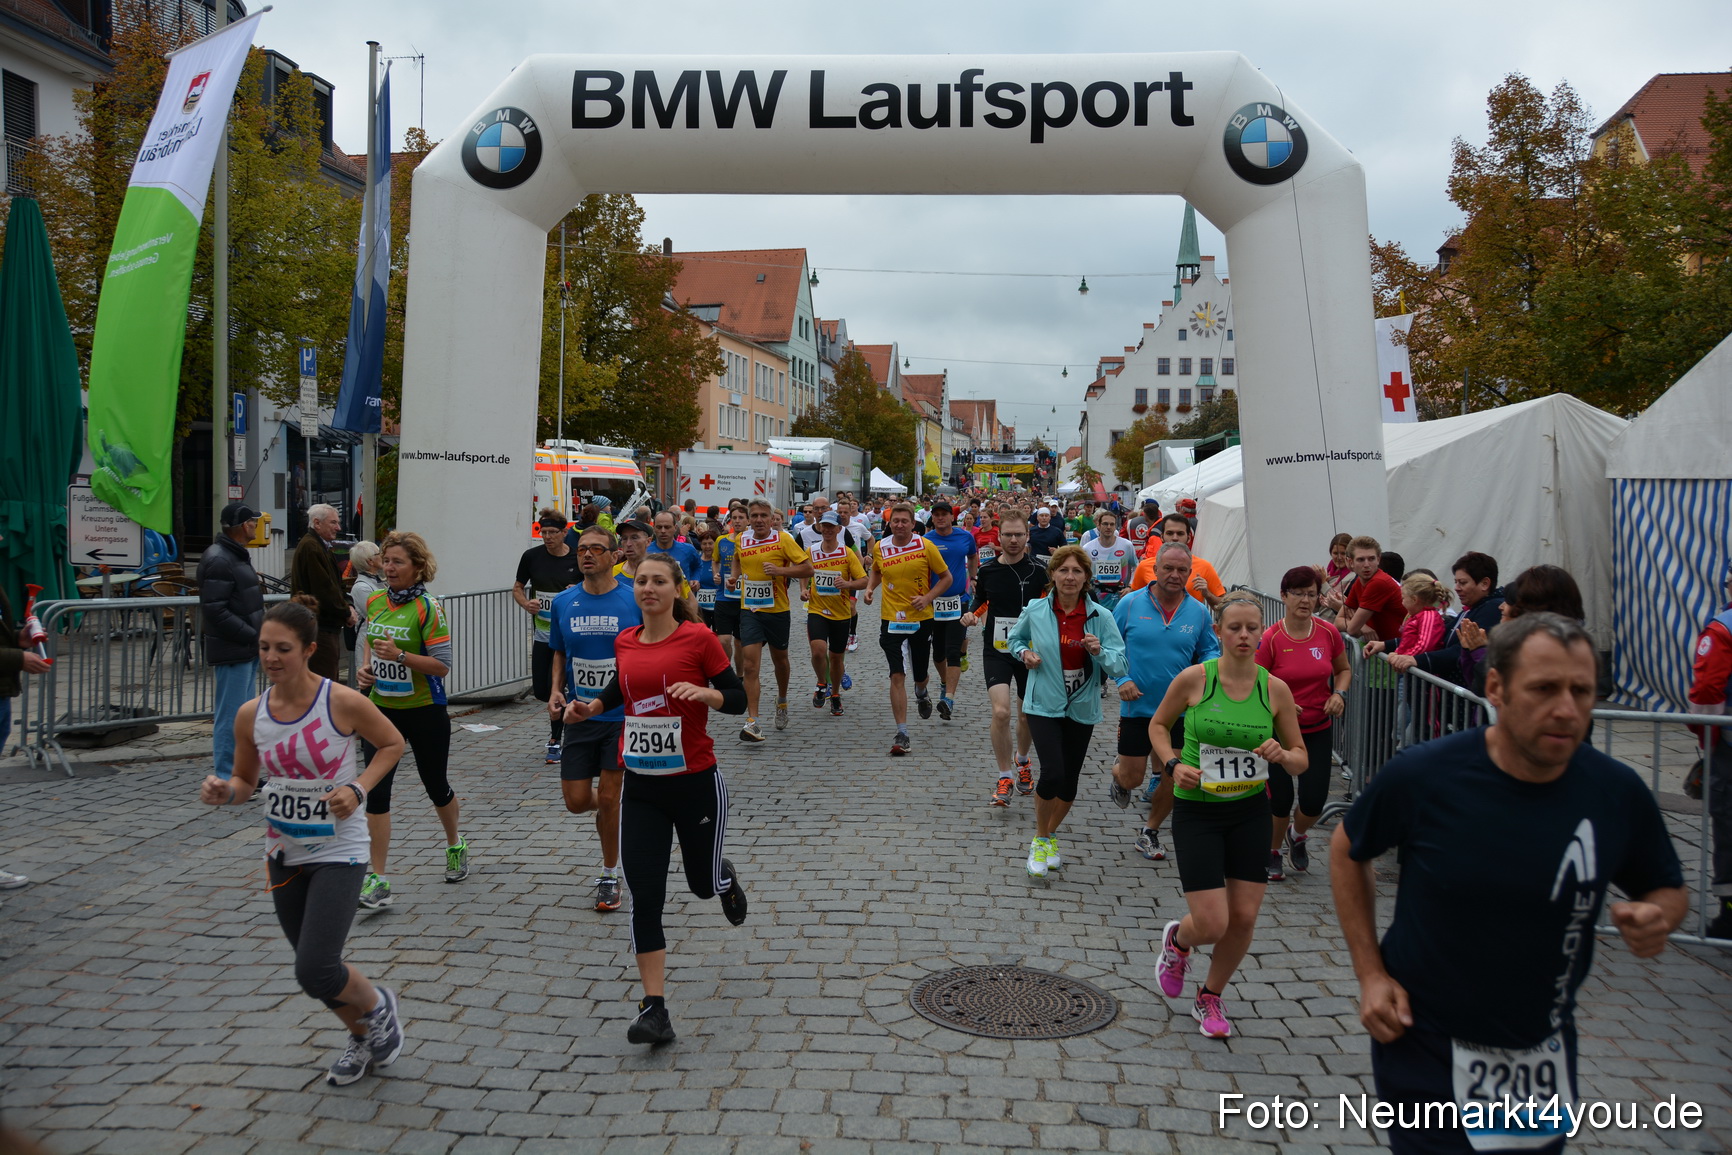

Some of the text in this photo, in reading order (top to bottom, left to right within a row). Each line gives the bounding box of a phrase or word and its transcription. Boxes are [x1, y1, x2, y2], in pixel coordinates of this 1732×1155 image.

[571, 68, 1195, 144] BMW Laufsport
[472, 109, 536, 135] BMW
[1231, 103, 1299, 131] BMW
[303, 347, 313, 371] P
[236, 399, 244, 429] P
[263, 448, 269, 461] 3
[1266, 450, 1382, 465] www.bmw-laufsport.de
[81, 515, 114, 524] Kreuzung
[84, 534, 128, 544] Kaserngasse
[760, 545, 782, 554] BÖGL
[830, 559, 848, 567] BÖGL
[883, 552, 927, 568] MAX BÖGL
[1098, 566, 1120, 574] 2692
[816, 575, 836, 586] 270
[698, 593, 716, 602] 2817
[746, 586, 771, 598] 2799
[539, 598, 552, 610] 30
[935, 600, 959, 611] 2196
[570, 615, 619, 627] HUBER
[373, 660, 407, 680] 2808
[577, 669, 616, 687] 2672
[642, 700, 656, 709] DEHN
[626, 721, 640, 729] PARTL
[629, 731, 677, 754] 2594
[638, 759, 667, 769] Regina
[1214, 756, 1256, 779] 113
[1216, 784, 1253, 792] Christina
[268, 792, 328, 820] 2054
[1467, 1059, 1557, 1101] 2209
